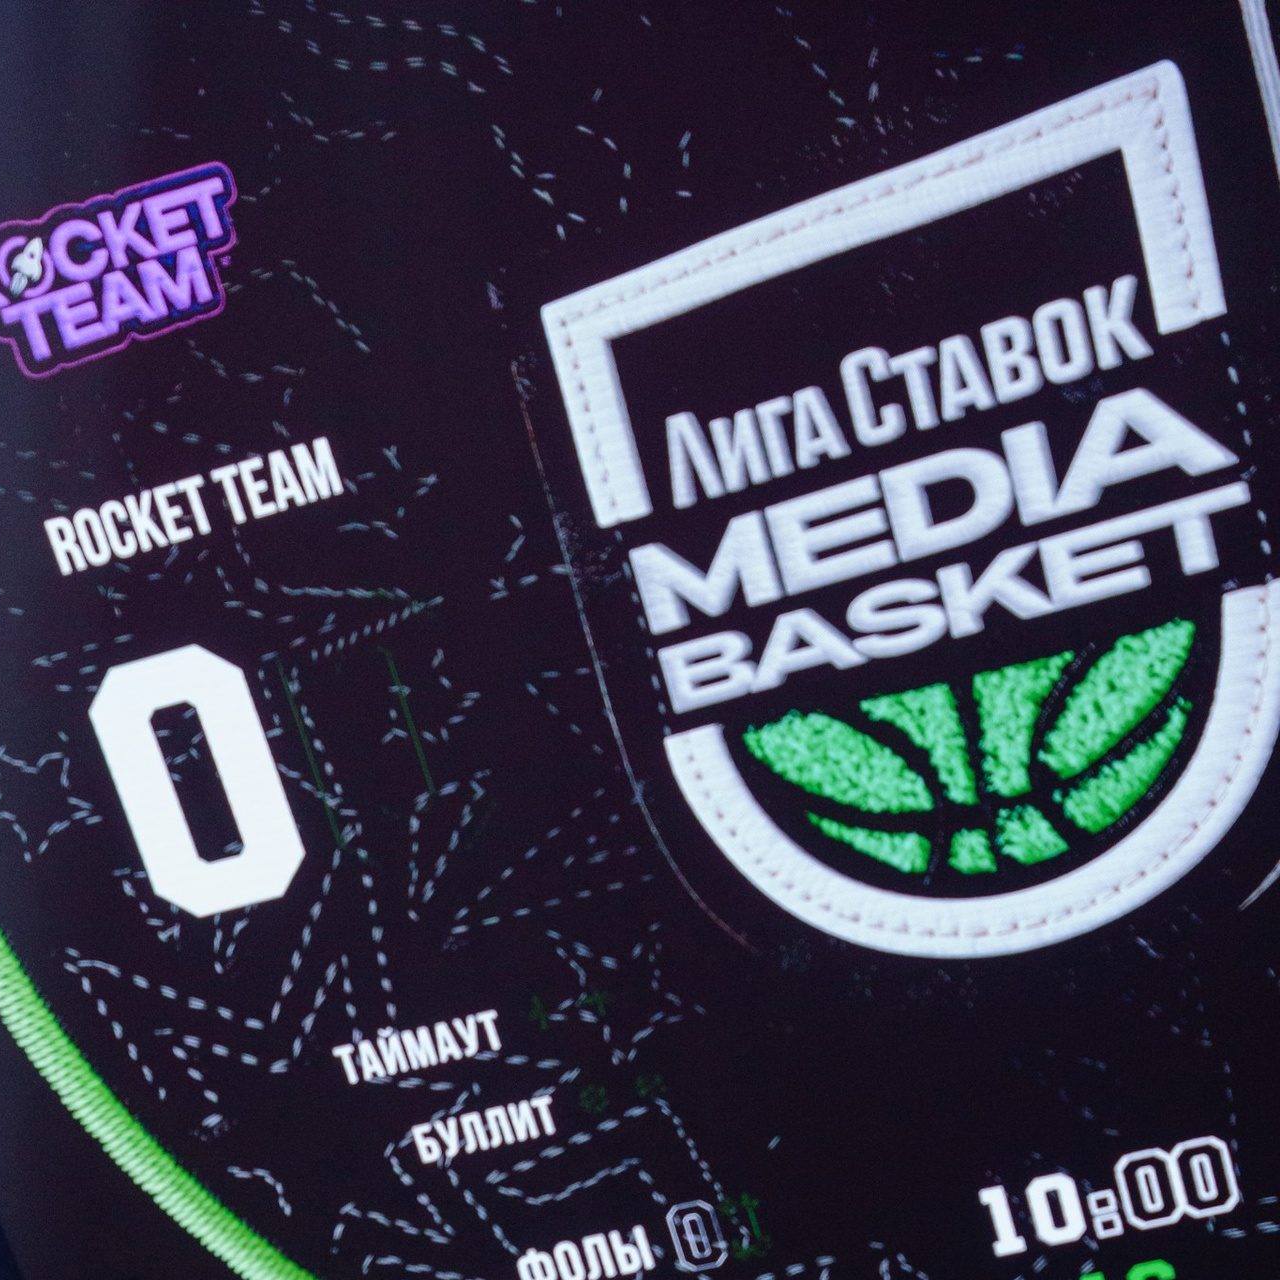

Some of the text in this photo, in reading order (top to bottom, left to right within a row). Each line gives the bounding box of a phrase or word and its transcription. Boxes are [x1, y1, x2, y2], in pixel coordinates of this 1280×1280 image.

[1, 245, 213, 362] TEAM
[666, 276, 1153, 508] ЛИГА СТАВОК
[43, 437, 344, 576] ROCKET TEAM
[629, 388, 1239, 635] MEDIA
[658, 482, 1251, 713] BASKET
[88, 643, 306, 918] 0
[332, 1009, 503, 1085] ТАЙМАУТ
[411, 1095, 556, 1164] БУЛЛИТ
[978, 1135, 1240, 1257] 10:00
